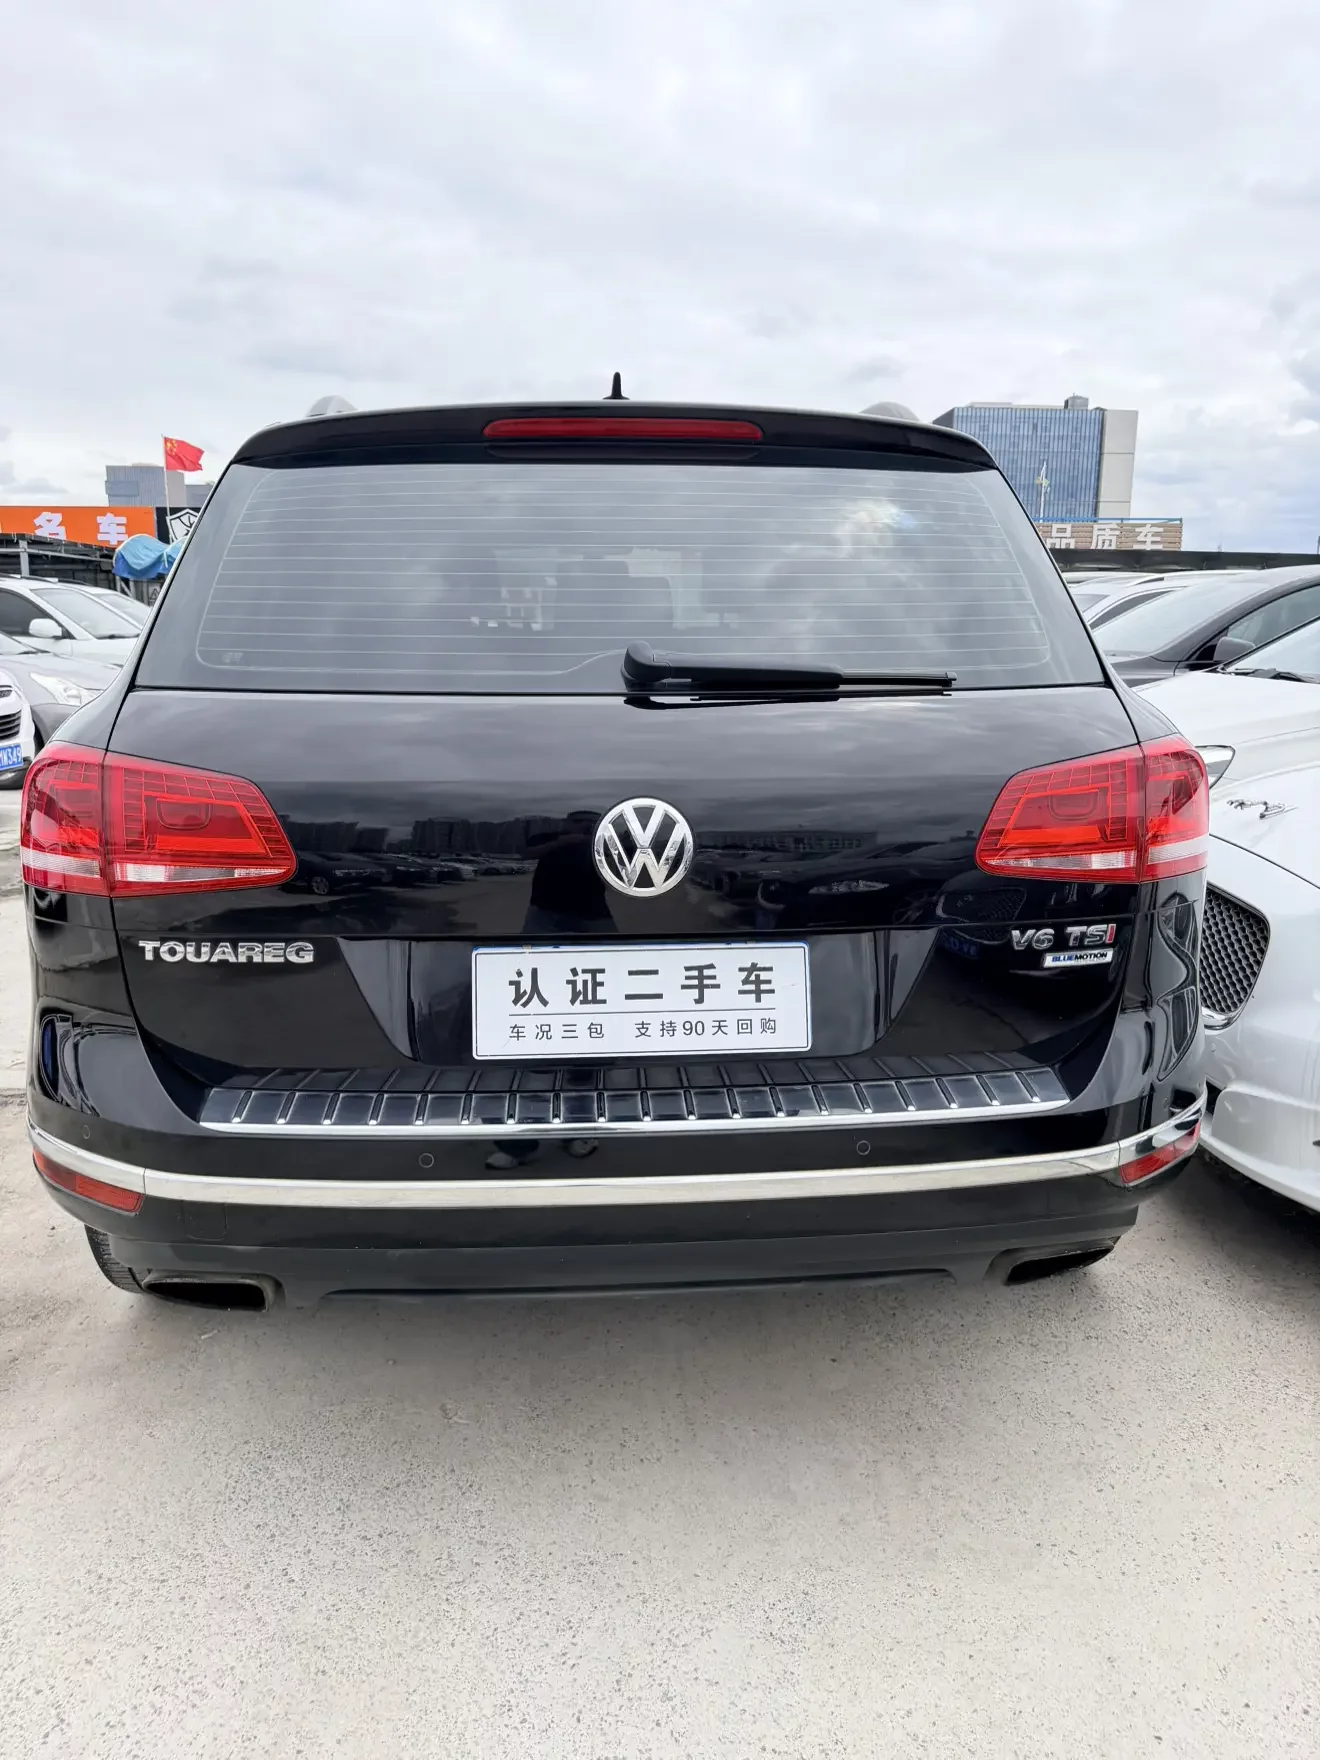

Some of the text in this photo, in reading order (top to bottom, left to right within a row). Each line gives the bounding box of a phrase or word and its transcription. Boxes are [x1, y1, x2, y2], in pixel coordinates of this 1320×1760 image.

[33, 511, 129, 546] 名车
[1046, 523, 1164, 550] 品质车
[1011, 924, 1116, 950] V6 TSI
[138, 940, 314, 963] TOUAREG
[1052, 952, 1108, 962] BLUEMOTION
[508, 962, 776, 1008] 认证二手车
[509, 1017, 777, 1041] 车况三包 支持90天回购
